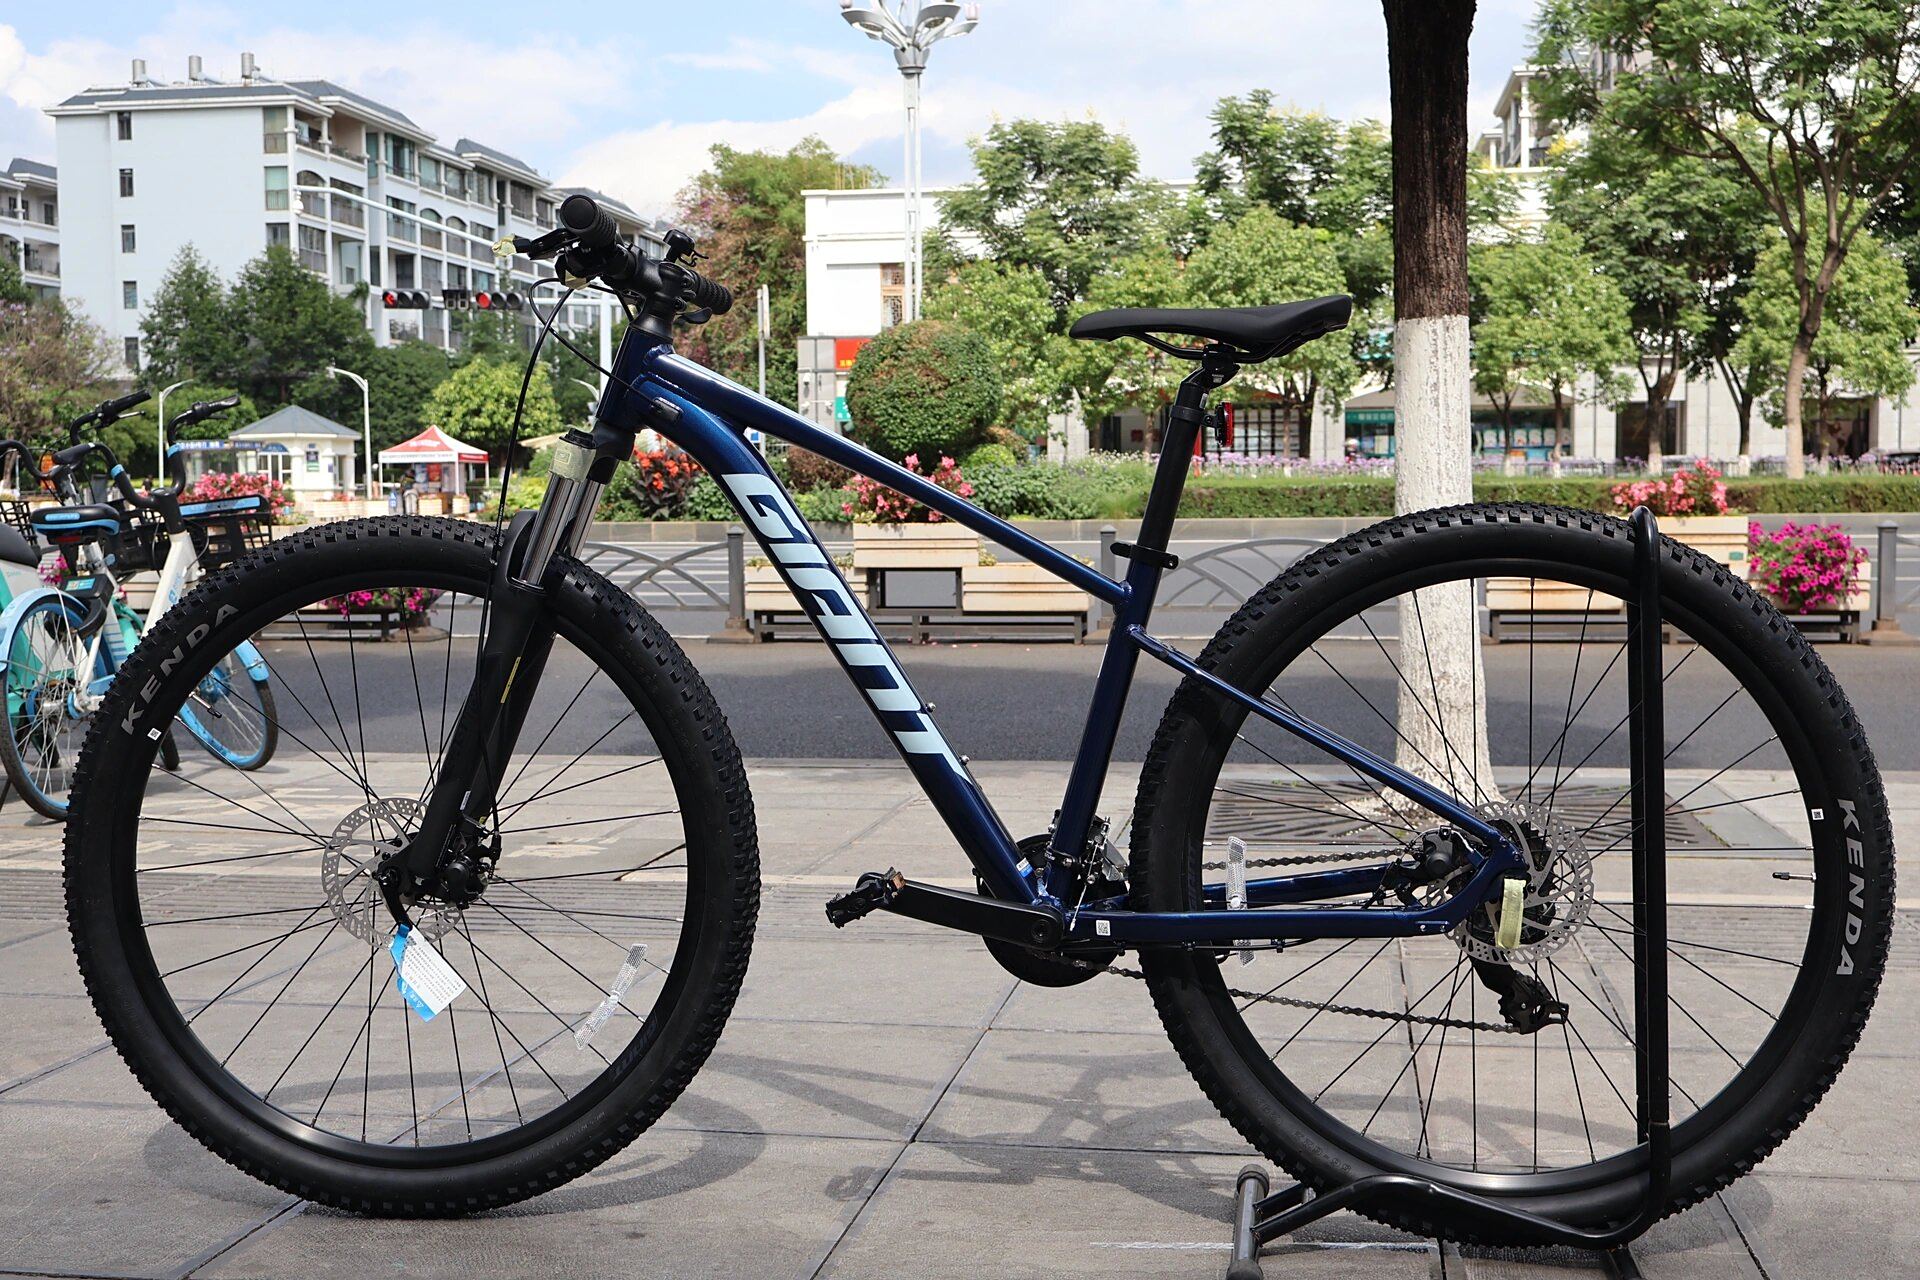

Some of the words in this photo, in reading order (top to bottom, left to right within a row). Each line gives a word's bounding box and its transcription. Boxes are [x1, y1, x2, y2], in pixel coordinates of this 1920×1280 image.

[121, 603, 239, 736] KENDA
[721, 474, 973, 785] GIANT
[1836, 799, 1865, 975] KENDA
